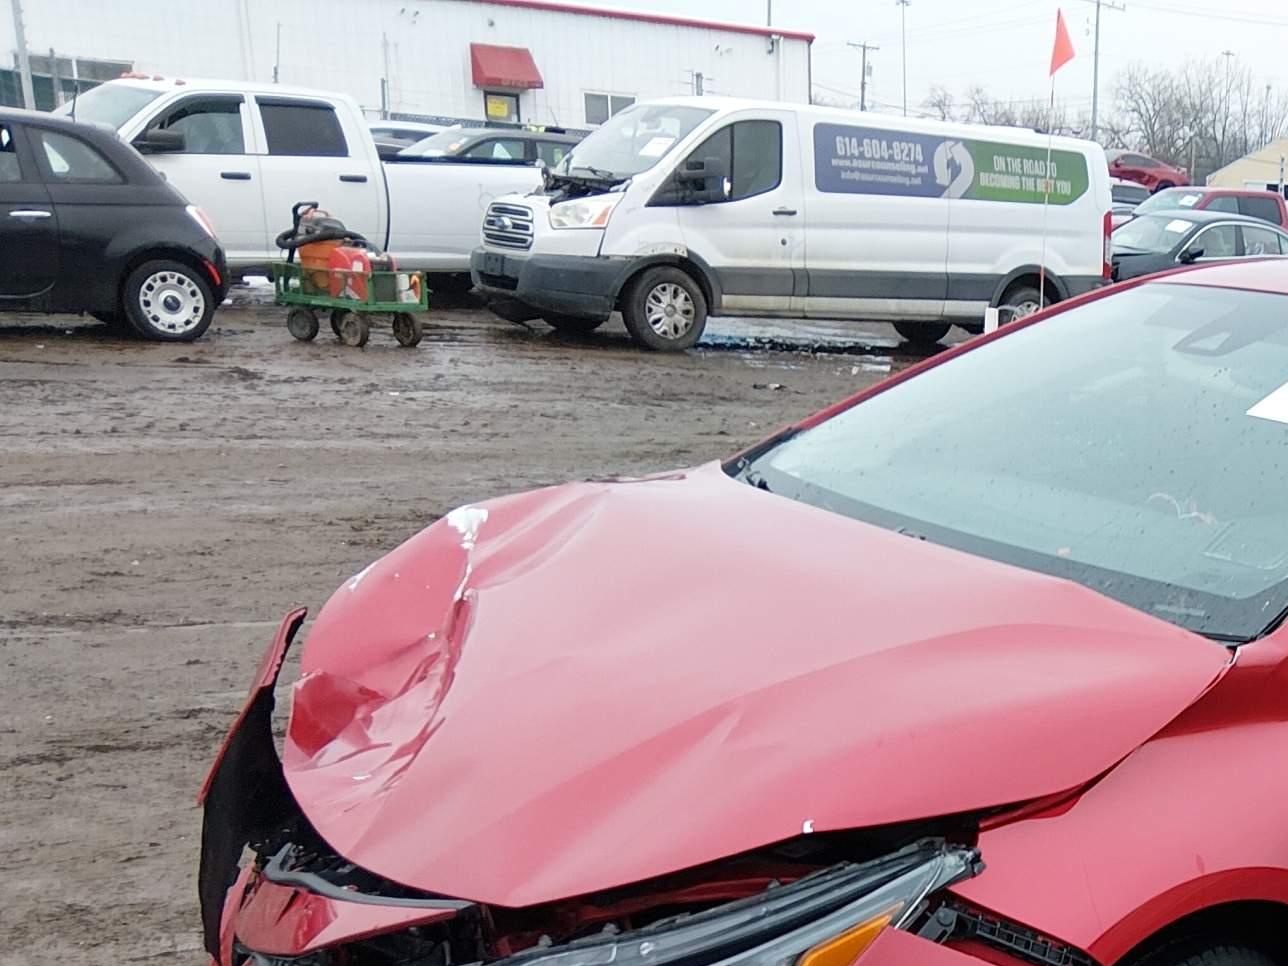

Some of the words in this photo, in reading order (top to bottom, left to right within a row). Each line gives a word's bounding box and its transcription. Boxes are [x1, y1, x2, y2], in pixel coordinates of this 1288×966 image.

[835, 135, 924, 163] 614-604-8274
[993, 155, 1006, 172] ON
[1006, 156, 1022, 174] THE
[1023, 158, 1045, 178] ROAD
[1021, 175, 1035, 192] THE
[1055, 180, 1072, 197] YOU
